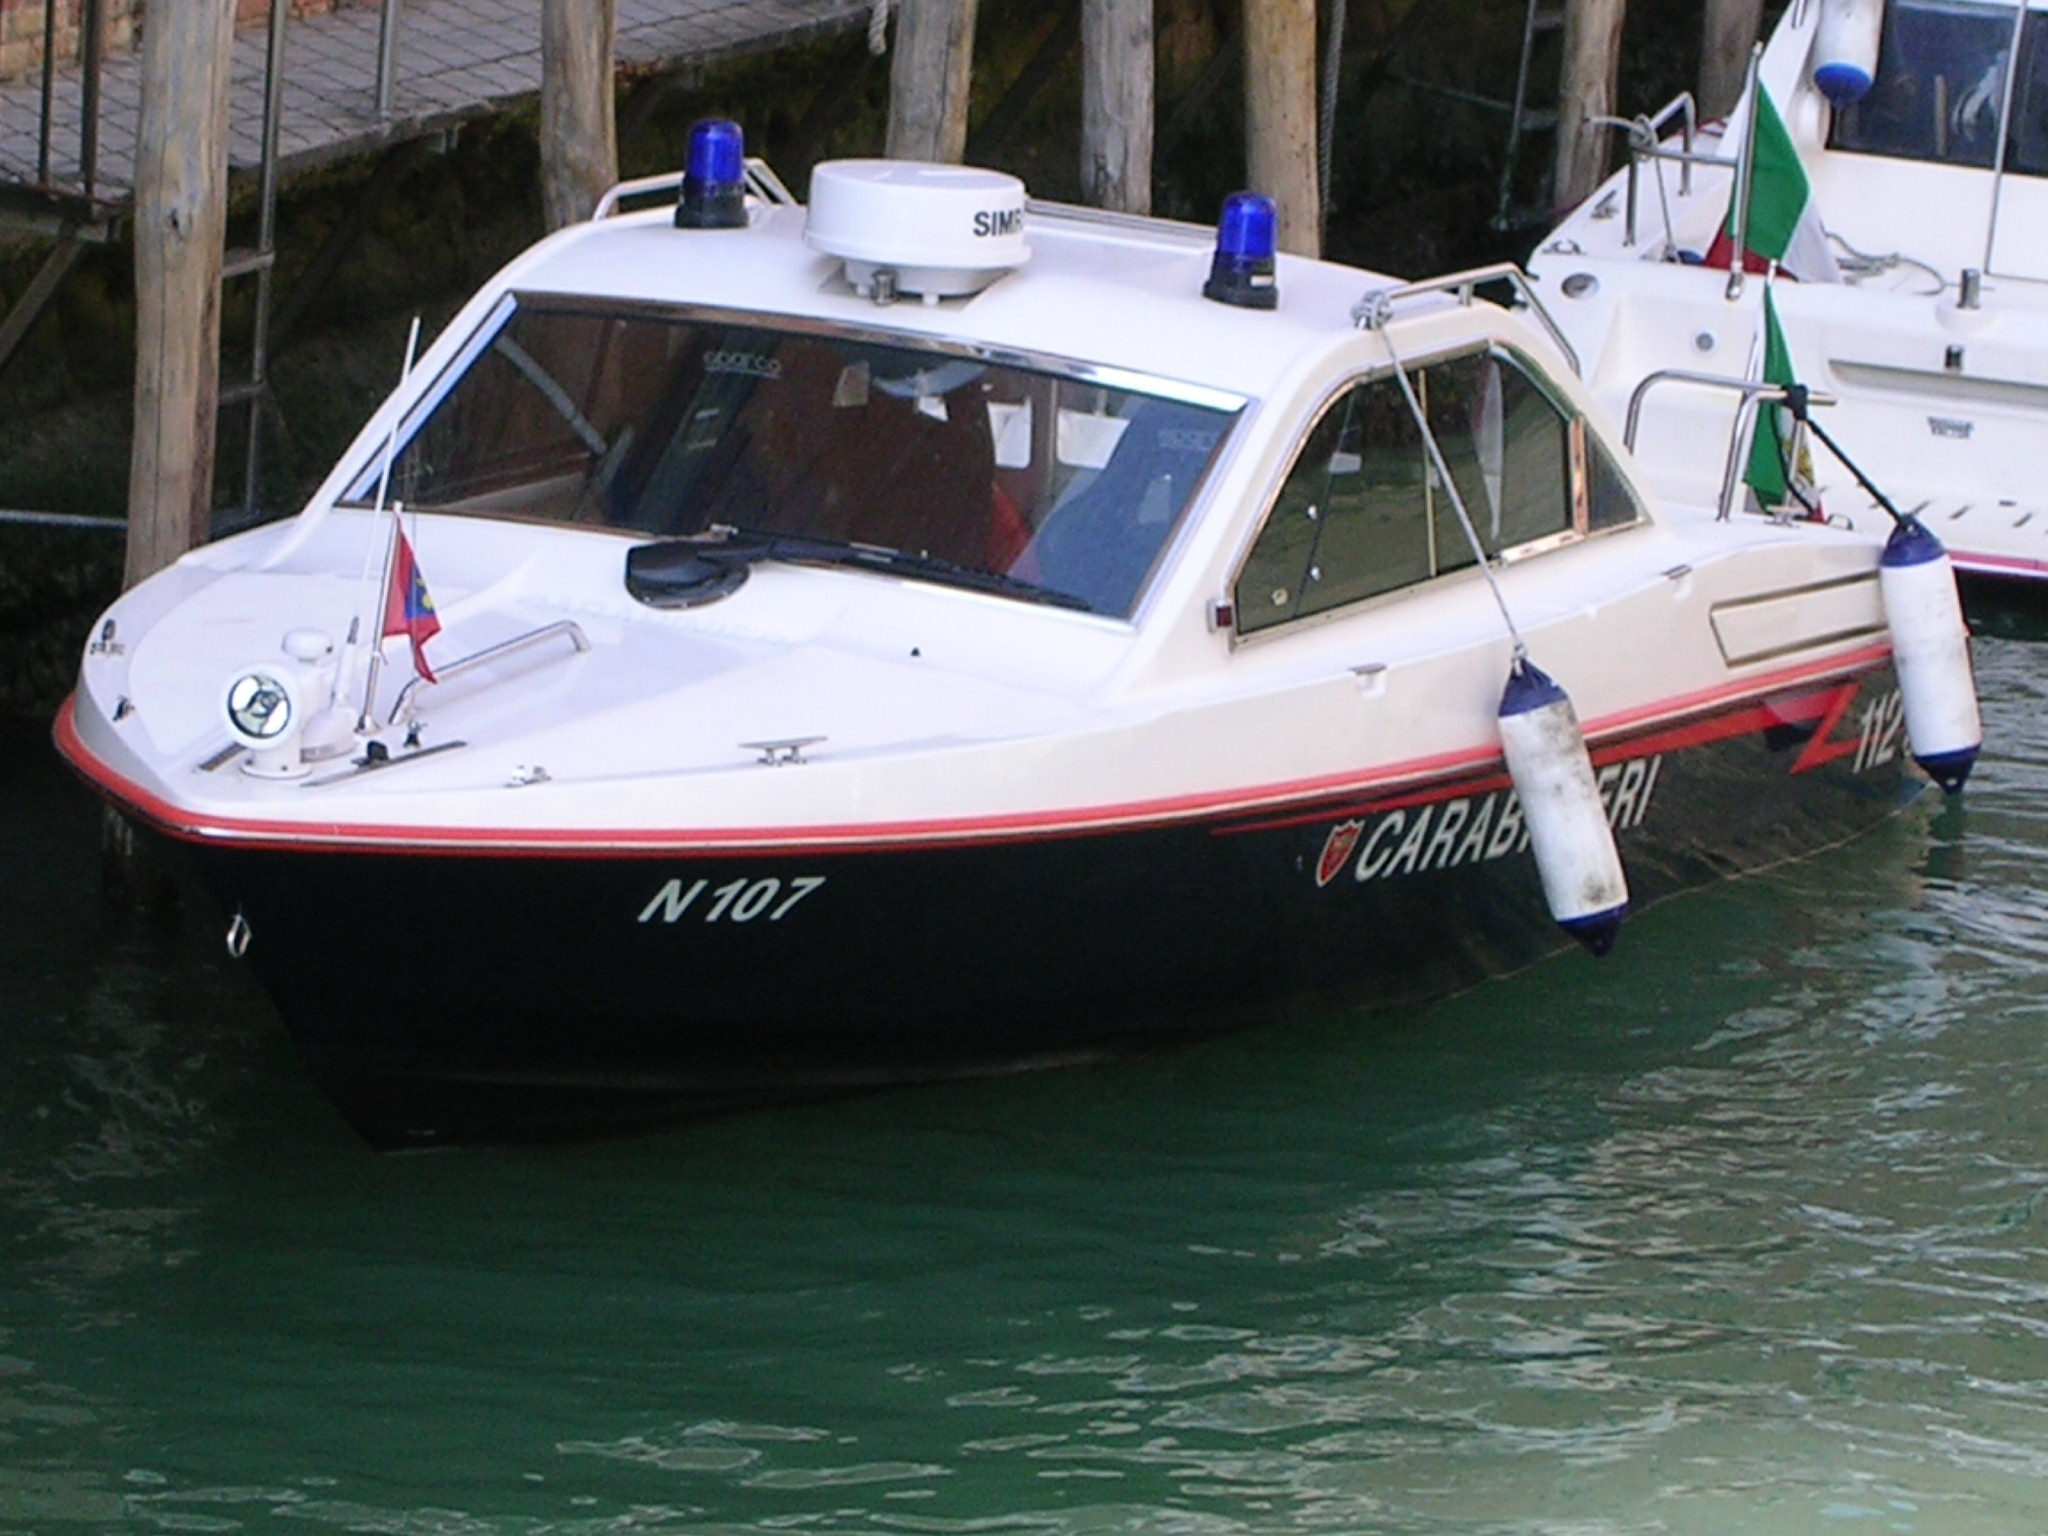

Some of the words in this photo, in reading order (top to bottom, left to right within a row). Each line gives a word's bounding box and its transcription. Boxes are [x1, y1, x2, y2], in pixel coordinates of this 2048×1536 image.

[1852, 689, 1904, 775] 112
[637, 878, 708, 923] N
[705, 876, 826, 922] 107
